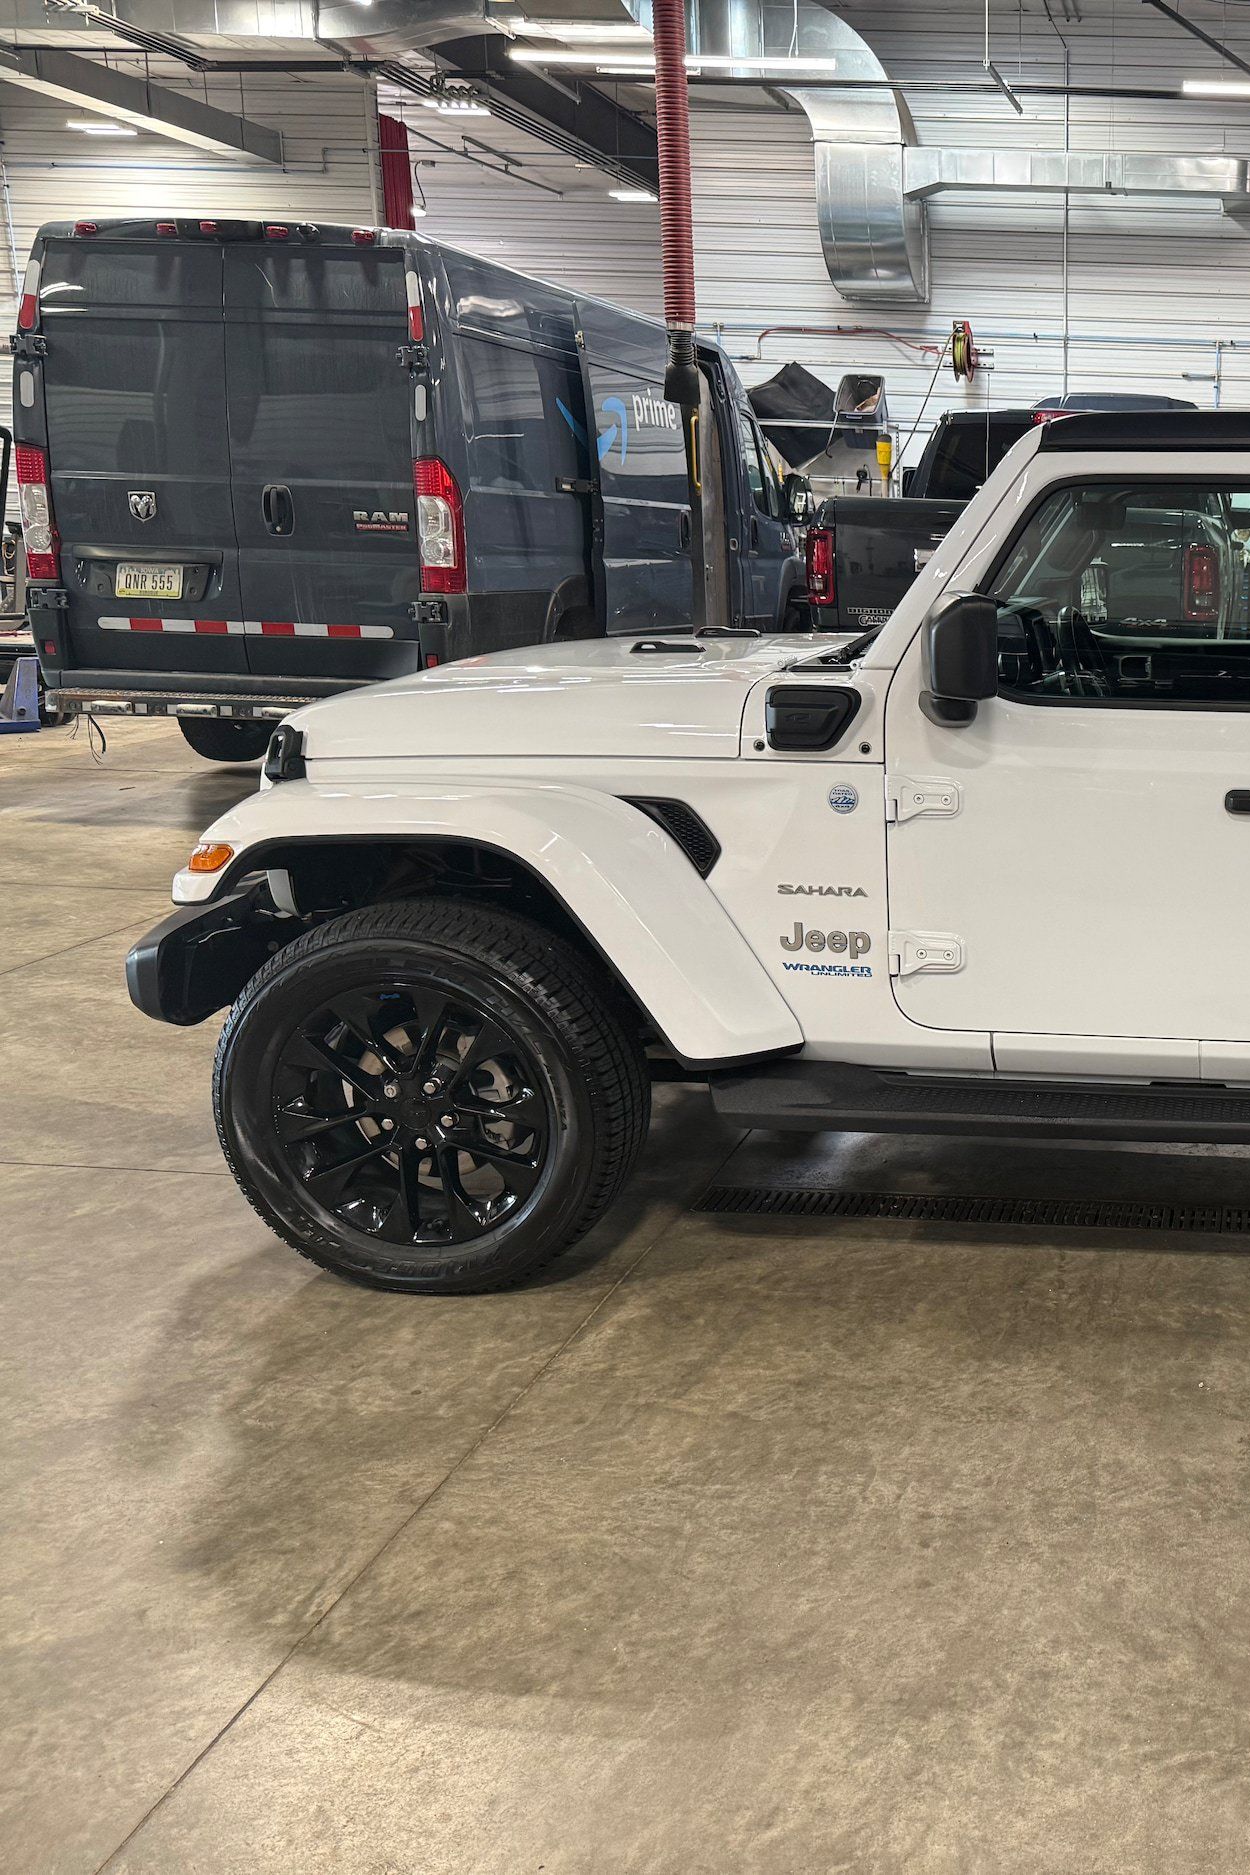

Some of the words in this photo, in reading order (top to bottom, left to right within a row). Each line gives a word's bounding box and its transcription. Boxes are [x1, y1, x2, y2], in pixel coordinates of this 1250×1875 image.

[632, 387, 677, 431] prime
[353, 511, 408, 521] RAM
[125, 574, 147, 590] QNR
[151, 575, 173, 591] 555
[777, 884, 869, 897] SAHARA
[780, 921, 872, 959] Jeep
[782, 962, 872, 974] WRANGLER
